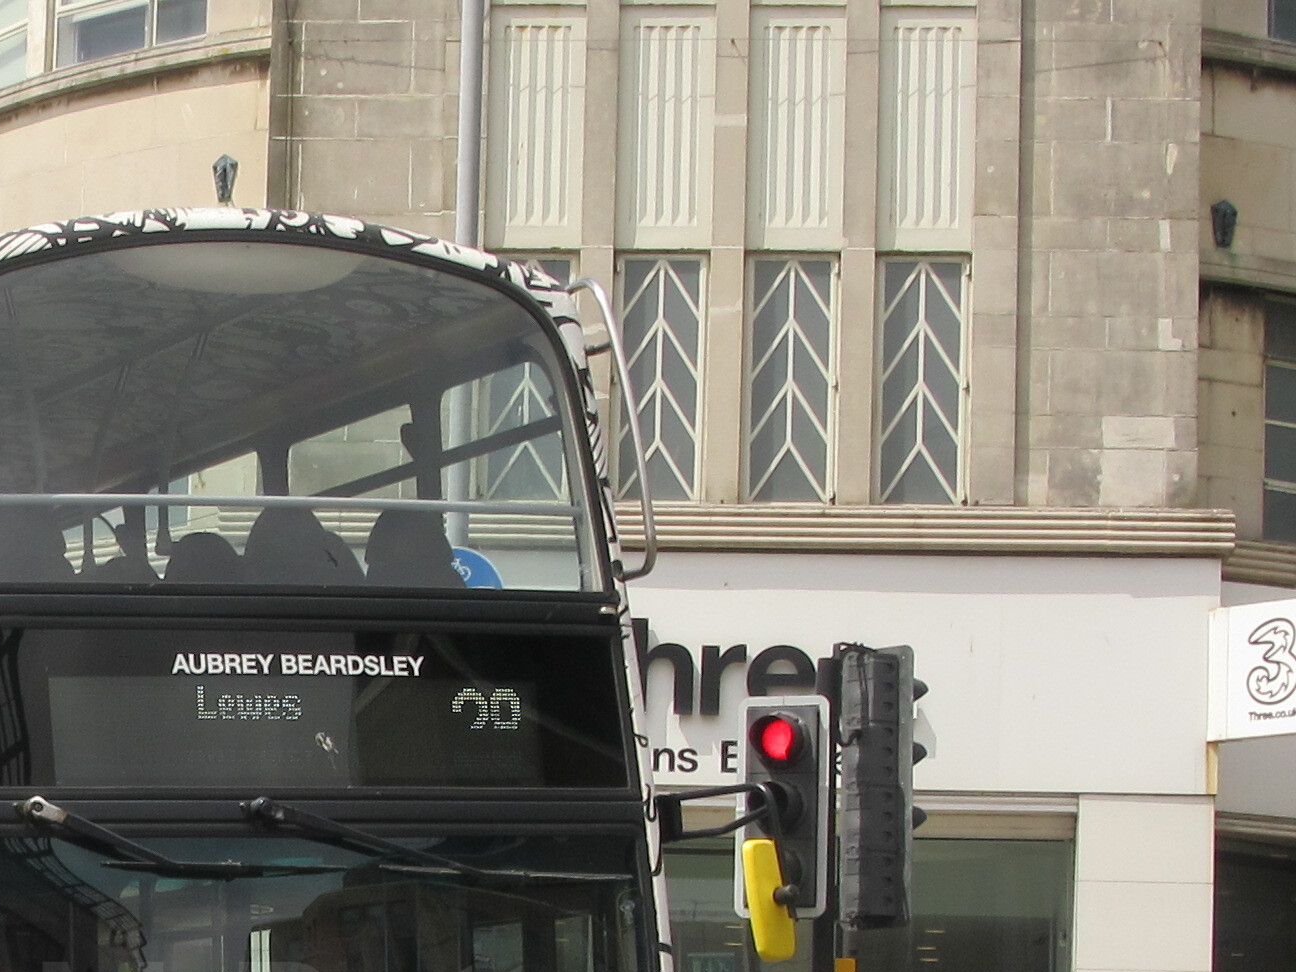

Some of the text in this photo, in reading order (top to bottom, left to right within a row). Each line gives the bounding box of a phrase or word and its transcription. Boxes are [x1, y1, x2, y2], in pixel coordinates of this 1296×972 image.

[171, 653, 424, 677] AUBREY BEARDSLEY
[631, 617, 816, 715] hre
[196, 685, 303, 720] Lewes
